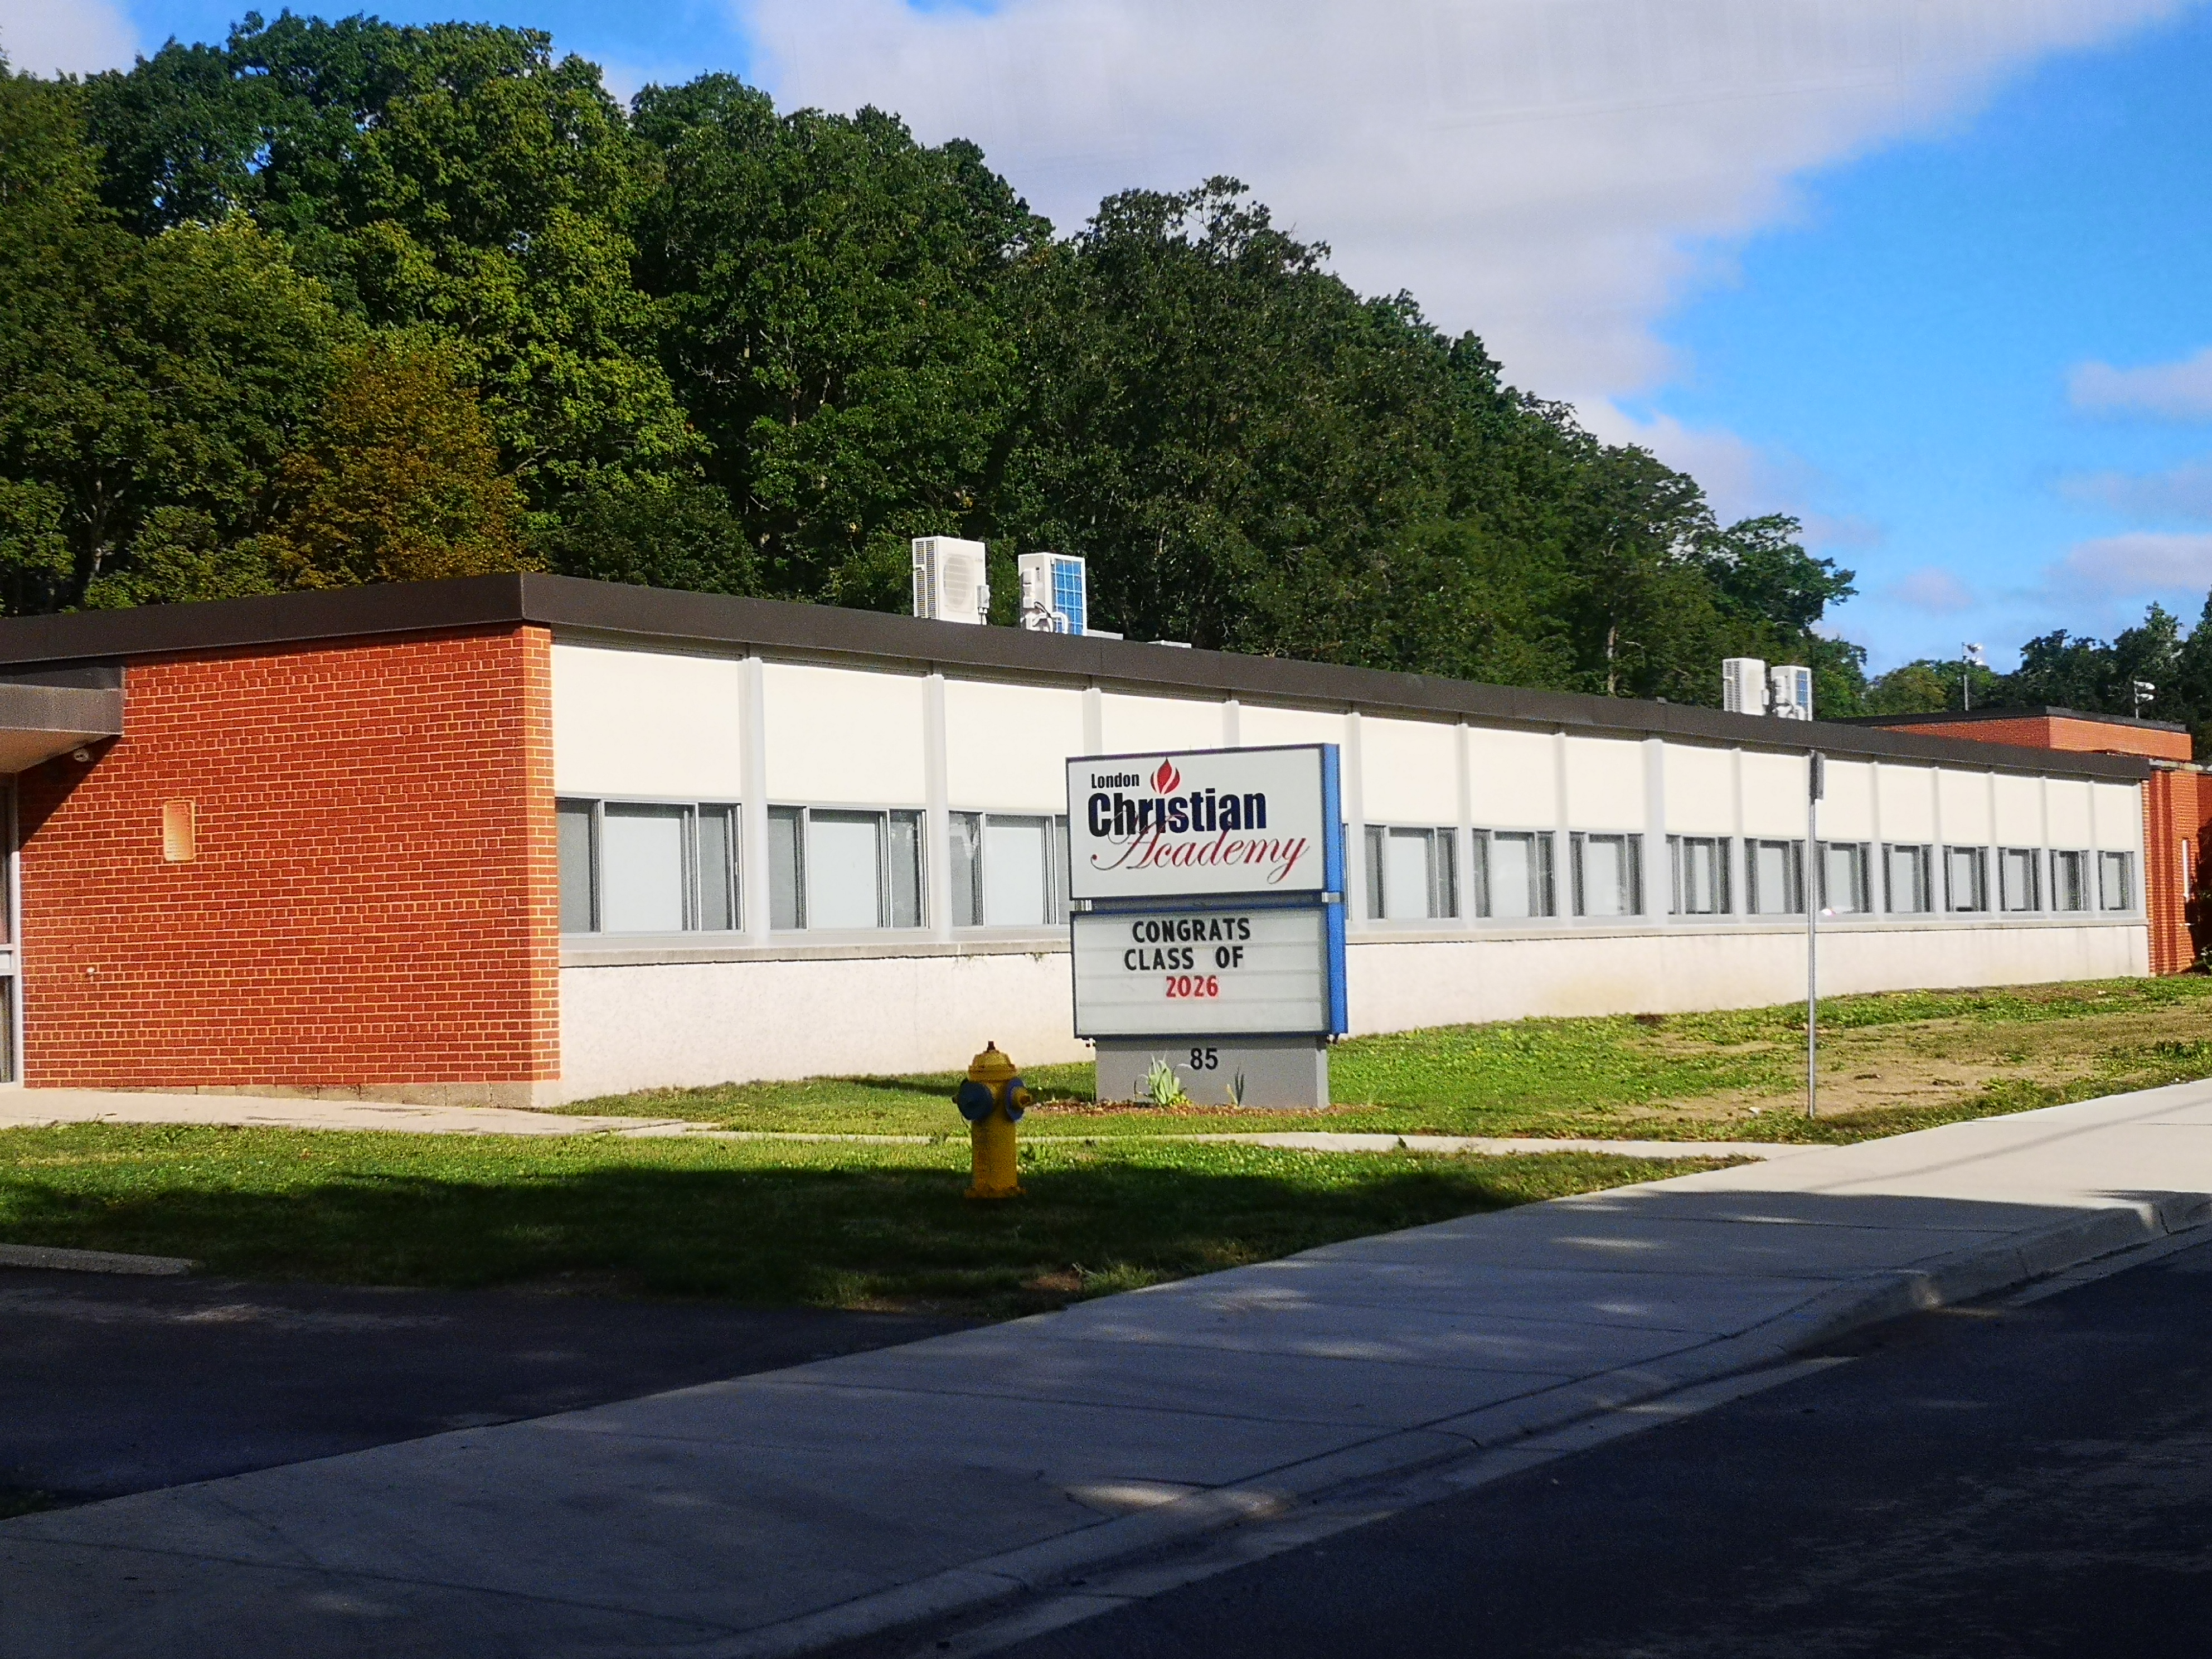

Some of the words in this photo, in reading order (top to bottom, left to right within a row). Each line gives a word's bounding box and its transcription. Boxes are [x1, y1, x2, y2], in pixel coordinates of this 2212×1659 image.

[1092, 773, 1139, 788] London
[1089, 788, 1267, 837] Christian
[1091, 810, 1310, 884] Academy
[1132, 918, 1250, 943] CONGRATS
[1124, 948, 1194, 970] CLASS
[1215, 946, 1244, 968] OF
[1166, 975, 1219, 998] 2026
[1190, 1047, 1218, 1070] 85
